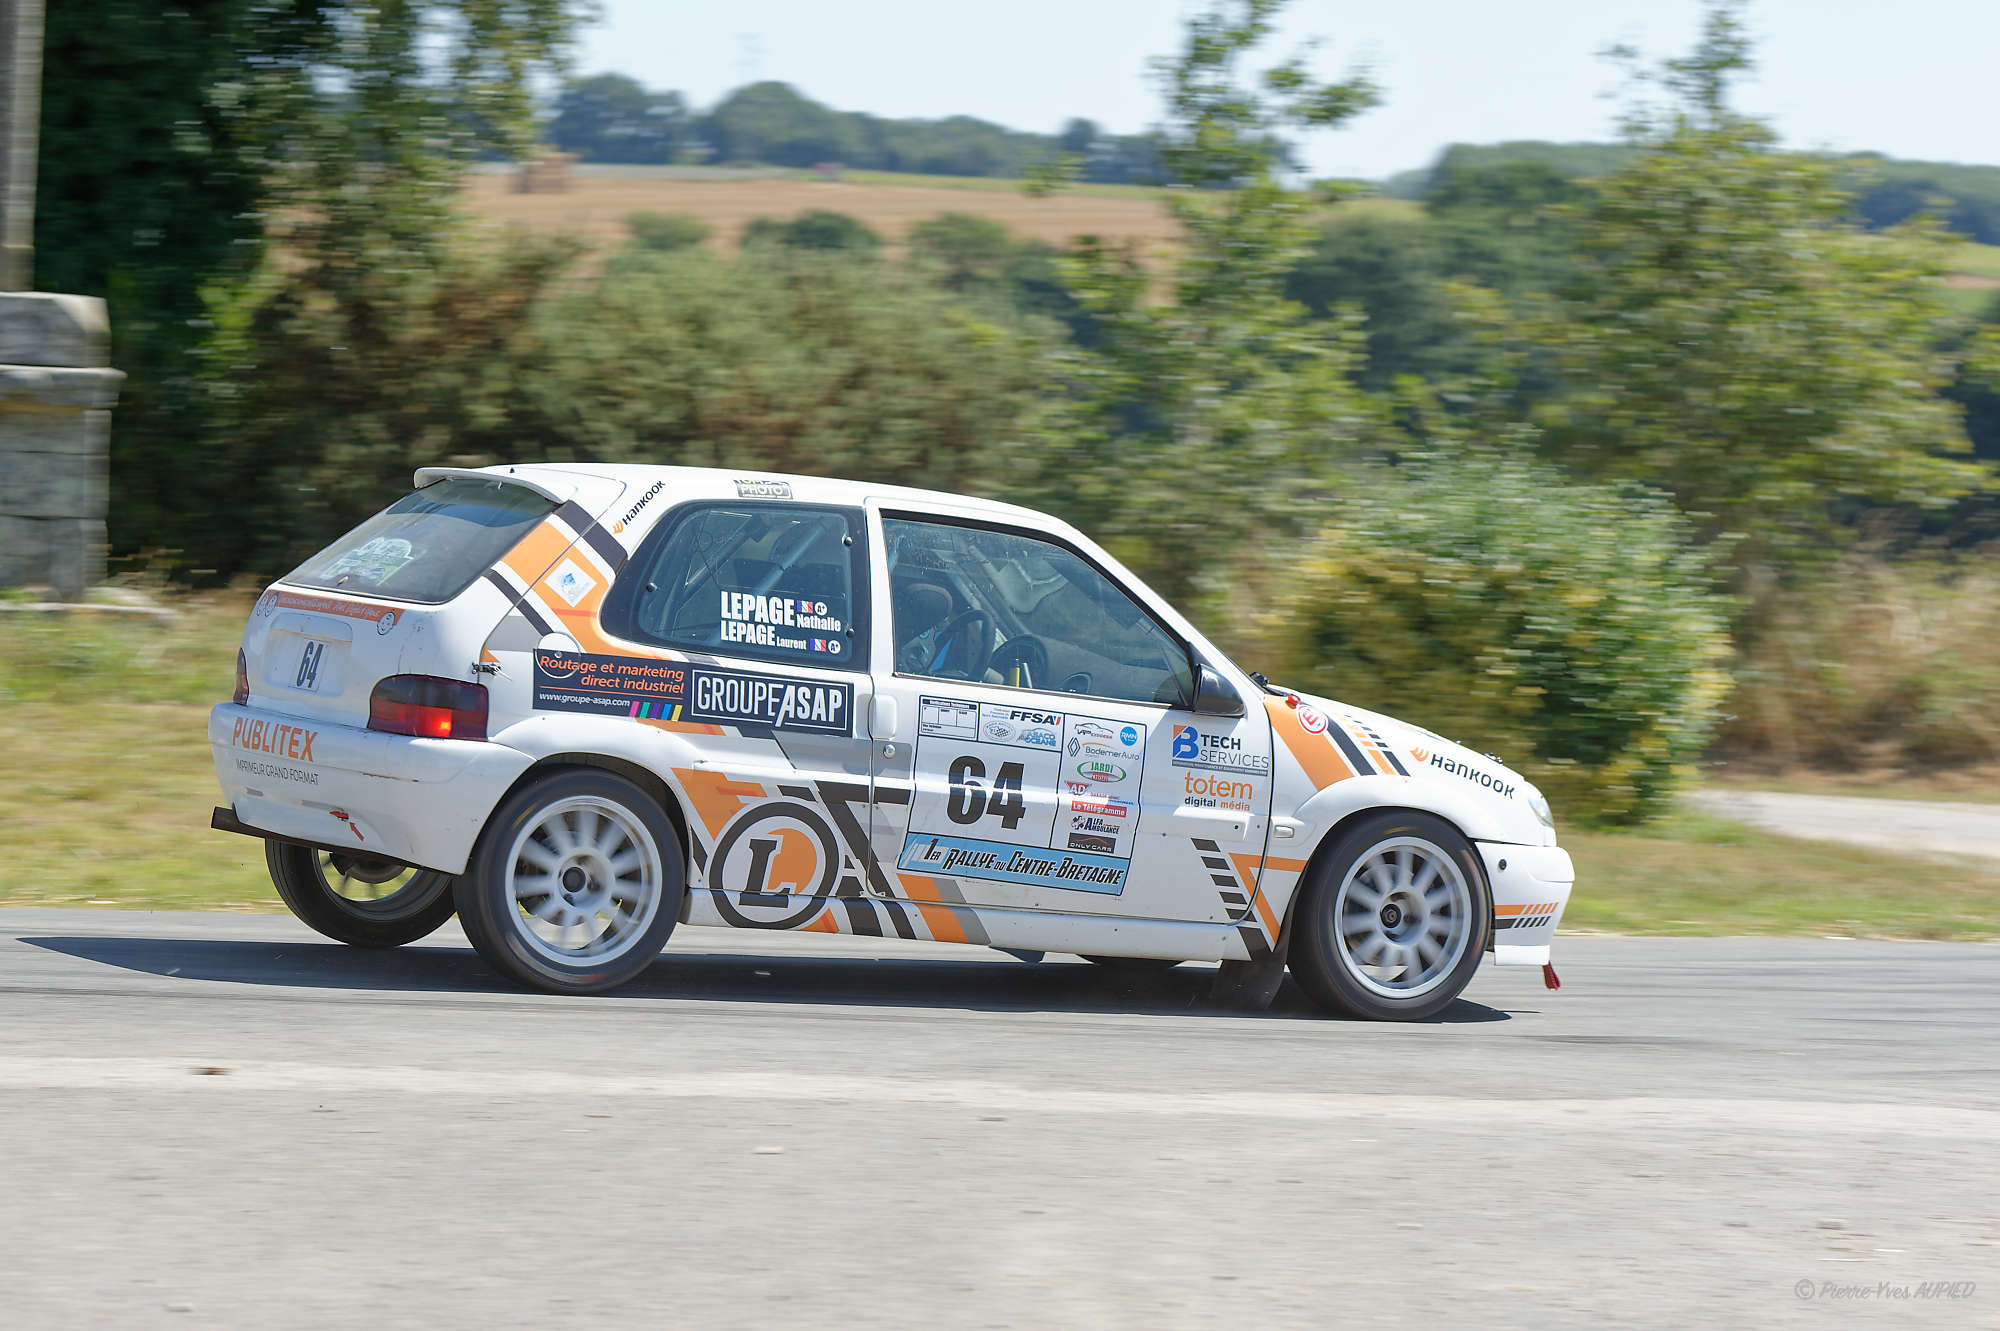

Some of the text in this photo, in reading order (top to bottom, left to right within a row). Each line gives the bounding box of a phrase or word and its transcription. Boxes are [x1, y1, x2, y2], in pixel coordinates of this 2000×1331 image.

[720, 590, 795, 627] LEPAGE
[796, 613, 841, 632] Nathalie
[720, 620, 777, 646] LEPAGE
[777, 635, 807, 650] Laurent
[296, 641, 324, 688] 64
[540, 655, 684, 681] Routage et marketing
[580, 674, 684, 694] direct industriel
[539, 692, 630, 707] www.groupe-asap.com
[1009, 710, 1055, 726] FFSA
[232, 716, 318, 762] PUBLITEX
[1200, 733, 1241, 751] TECH
[1199, 749, 1270, 769] SERVICES
[266, 764, 289, 780] GRAND
[289, 768, 319, 785] FORMAT
[1184, 771, 1253, 800] totem
[946, 755, 1027, 830] 64
[1184, 796, 1251, 811] digital média
[1082, 803, 1125, 816] Télégramme
[739, 839, 791, 909] L
[942, 848, 997, 871] RALLYE
[993, 860, 1007, 870] DU
[1006, 850, 1125, 886] CENTRE-BRETAGNE
